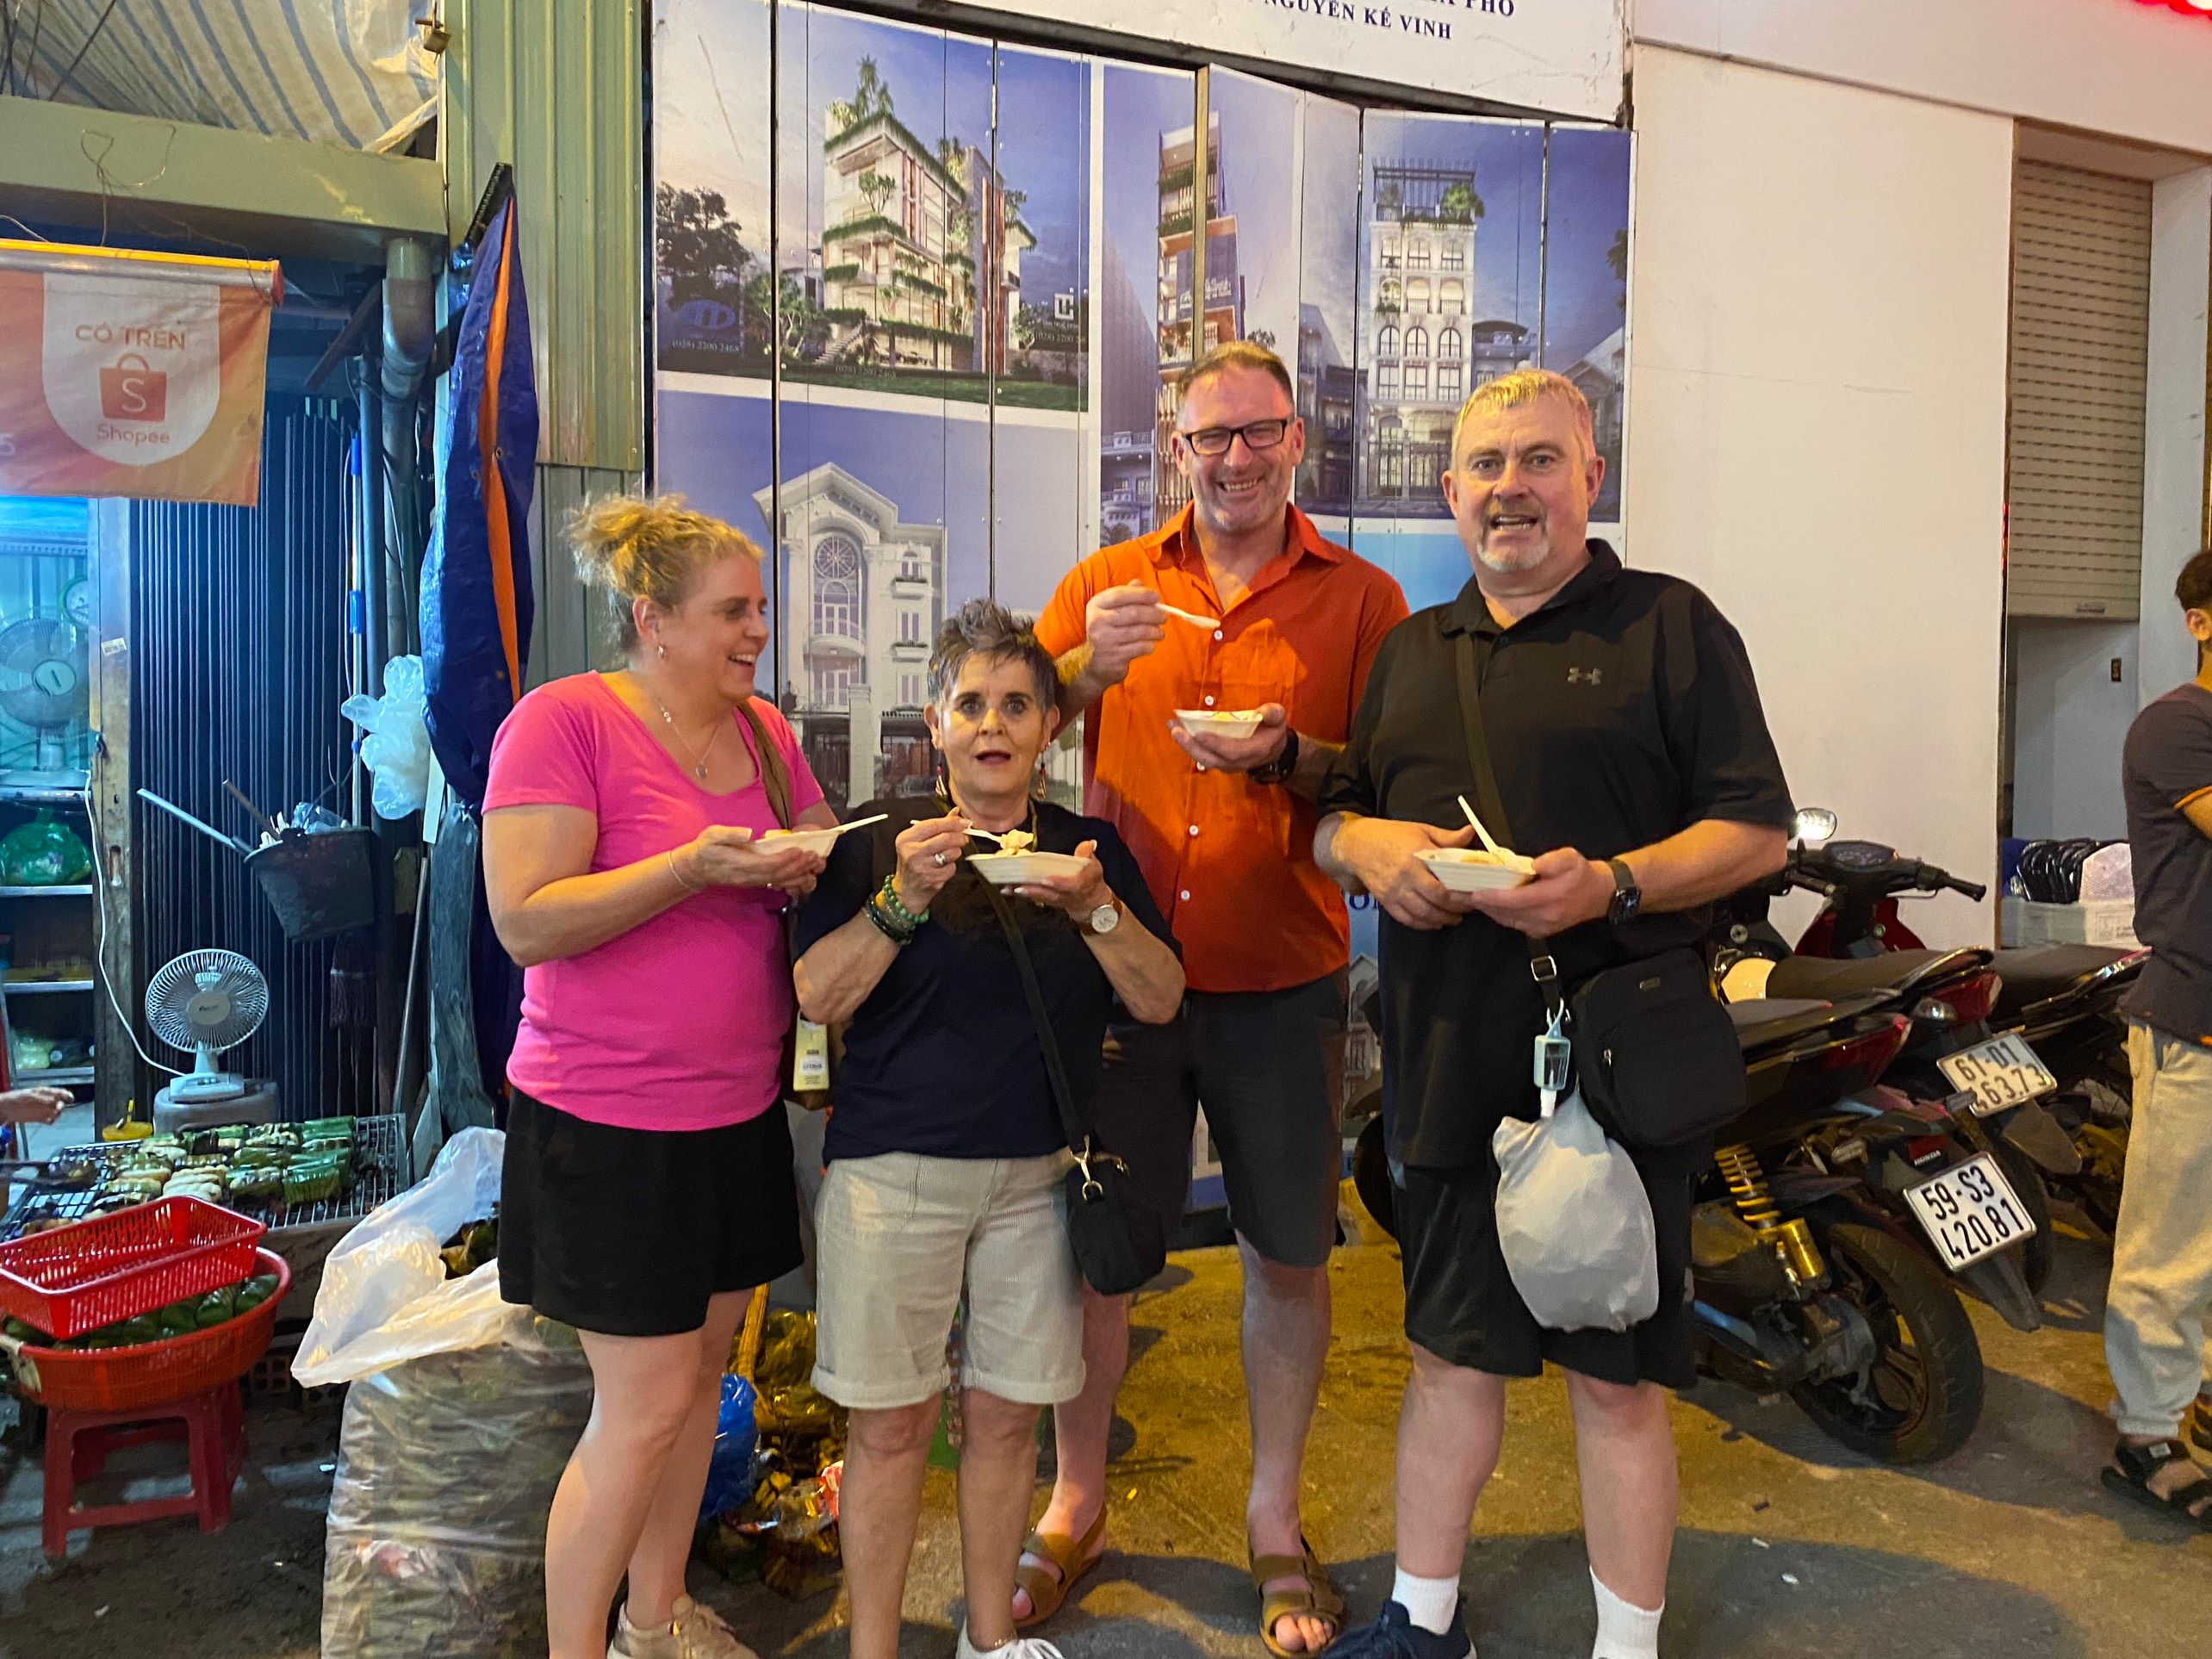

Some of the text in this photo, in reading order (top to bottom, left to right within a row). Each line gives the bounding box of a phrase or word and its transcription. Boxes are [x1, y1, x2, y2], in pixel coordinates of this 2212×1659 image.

[1399, 14, 1451, 40] VINH
[121, 377, 146, 413] S
[96, 423, 171, 447] Shopee
[1940, 1198, 2025, 1260] 420.81
